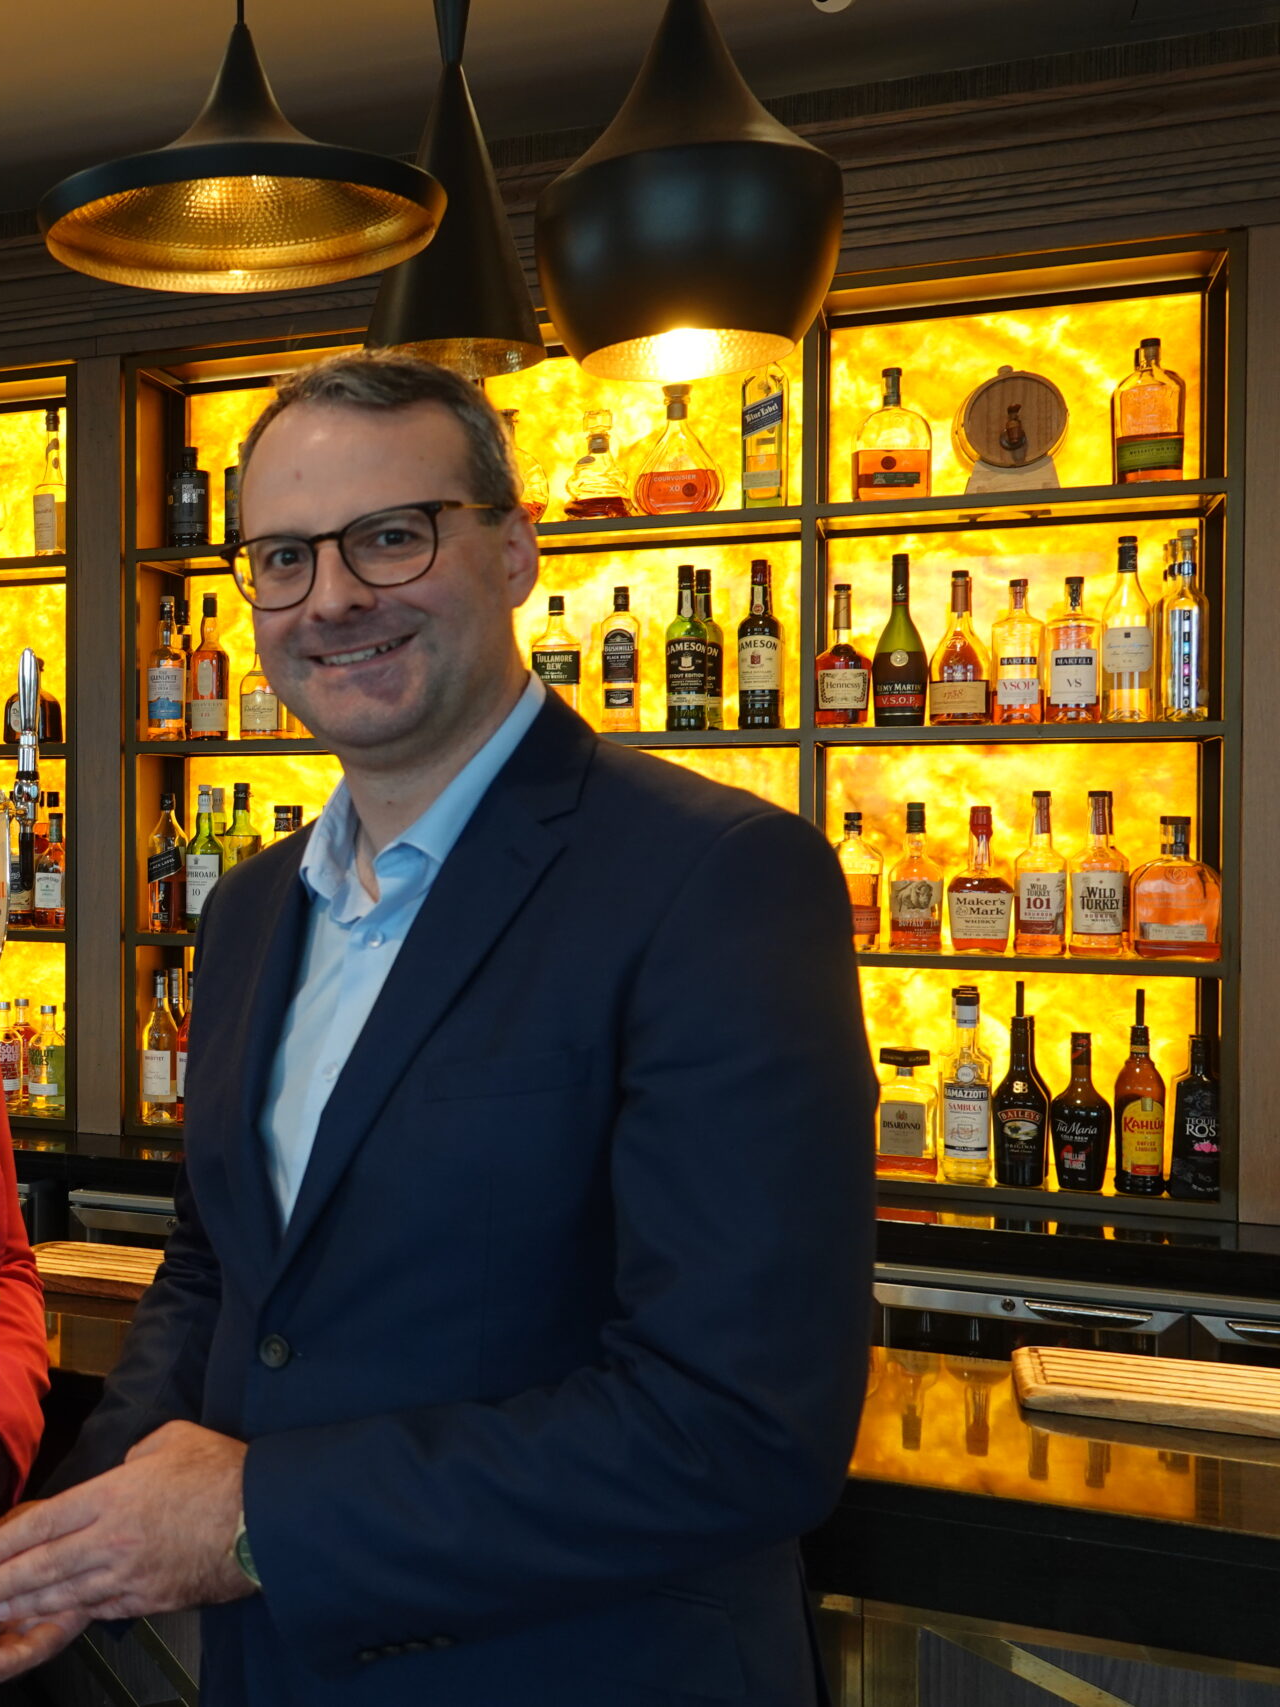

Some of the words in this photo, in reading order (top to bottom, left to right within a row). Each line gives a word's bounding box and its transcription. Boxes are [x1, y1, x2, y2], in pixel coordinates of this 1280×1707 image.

[536, 654, 573, 662] TULLAMORE
[826, 681, 861, 690] Hennessy
[1002, 681, 1035, 690] VSOP
[1066, 679, 1082, 688] VS
[1030, 883, 1047, 891] WILD
[1026, 889, 1051, 898] TURKEY
[1086, 887, 1116, 899] WILD
[955, 898, 1006, 907] Maker's
[1026, 898, 1051, 910] 101
[1080, 896, 1120, 911] TURKEY
[970, 906, 1005, 916] Mark
[948, 1103, 982, 1112] SAMBUCA
[1000, 1111, 1041, 1122] BAILEYS
[882, 1120, 921, 1130] DISARONNO
[1055, 1119, 1068, 1133] Tia
[1069, 1121, 1098, 1135] Maria
